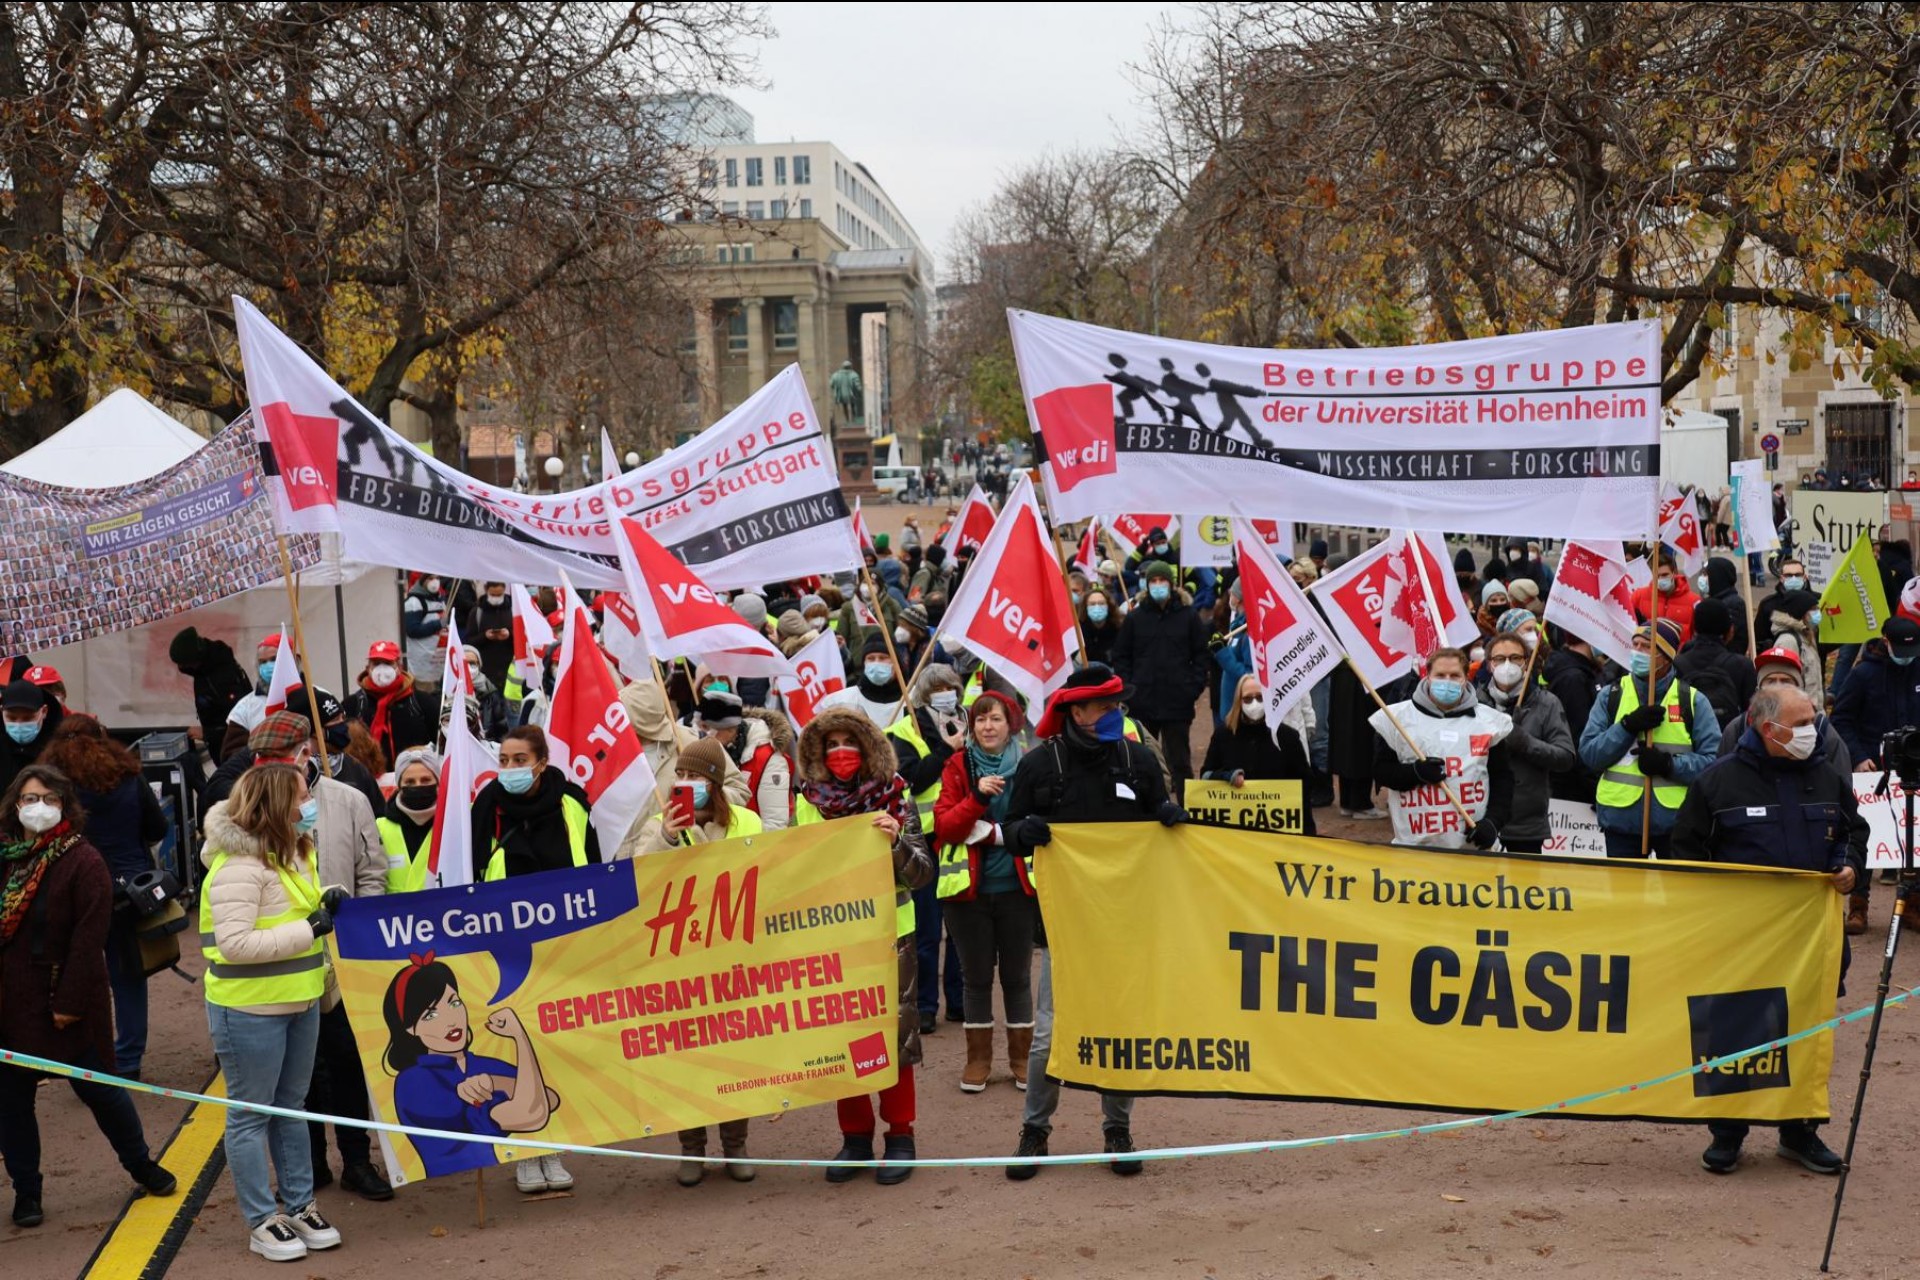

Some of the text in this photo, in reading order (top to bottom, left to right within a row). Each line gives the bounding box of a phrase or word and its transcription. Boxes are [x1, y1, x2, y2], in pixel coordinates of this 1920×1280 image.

[1263, 356, 1647, 389] Betriebsgruppe
[1262, 393, 1647, 425] der Universität Hohenheim
[1055, 439, 1108, 470] ver.di
[1125, 426, 1176, 451] FB5:
[1189, 431, 1282, 465] BILDUNG
[1317, 450, 1473, 479] WISSENSCHAFT
[1510, 450, 1643, 477] FORSCHUNG
[698, 443, 821, 507] Stuttgart
[86, 530, 121, 549] WIR
[123, 513, 176, 540] ZEIGEN
[177, 491, 232, 522] GESICHT
[349, 477, 404, 512] FB5:
[417, 489, 516, 537] BILDUNG
[719, 496, 837, 551] FORSCHUNG
[1206, 790, 1281, 801] Wir brauchen
[1460, 780, 1485, 804] ES
[1189, 803, 1301, 829] THE CÄSH
[1570, 835, 1586, 853] für
[1588, 838, 1604, 852] die
[1276, 860, 1574, 912] Wir brauchen
[378, 888, 599, 949] We Can Do It!
[644, 865, 877, 958] H&M HEILBRONN
[537, 952, 844, 1035] GEMEINSAM KÄMPFEN
[1228, 928, 1631, 1034] THE CÄSH
[620, 984, 888, 1061] GEMEINSAM LEBEN!
[803, 1052, 847, 1068] ver.di Bezirk
[856, 1054, 888, 1070] ver.di
[1077, 1035, 1251, 1074] #THECAESH
[1700, 1050, 1782, 1076] ver.di
